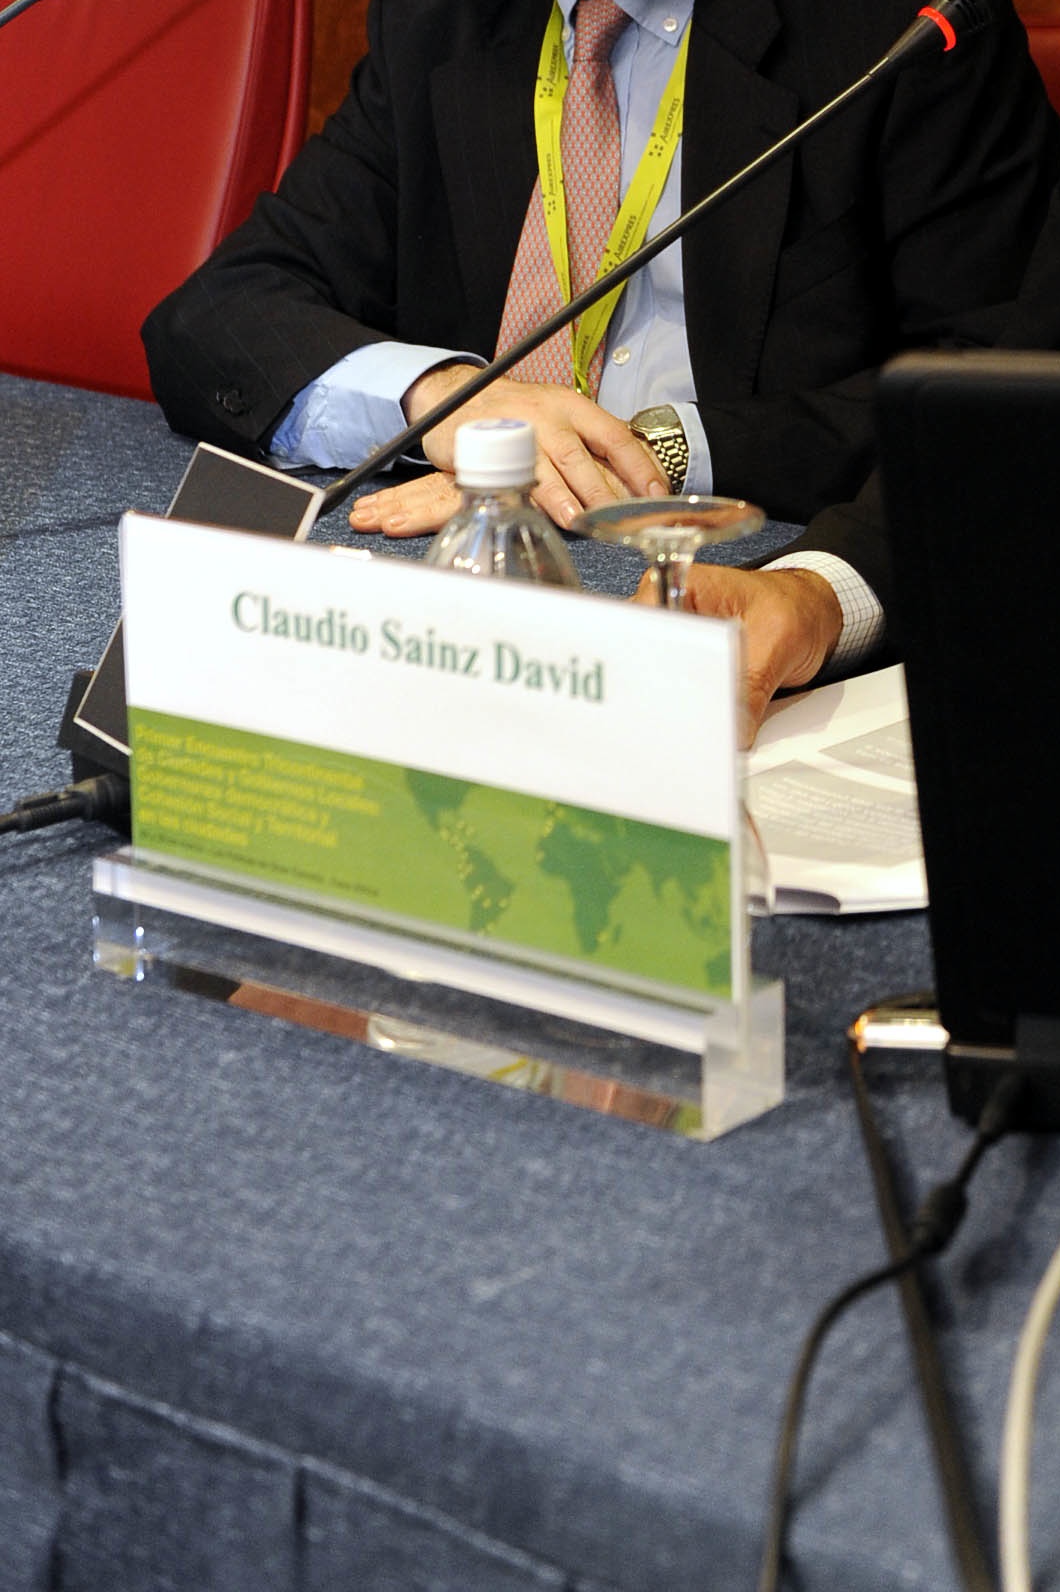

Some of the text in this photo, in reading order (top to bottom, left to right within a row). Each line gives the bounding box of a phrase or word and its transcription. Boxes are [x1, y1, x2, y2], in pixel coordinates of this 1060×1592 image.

[231, 590, 604, 704] Claudio Sainz David
